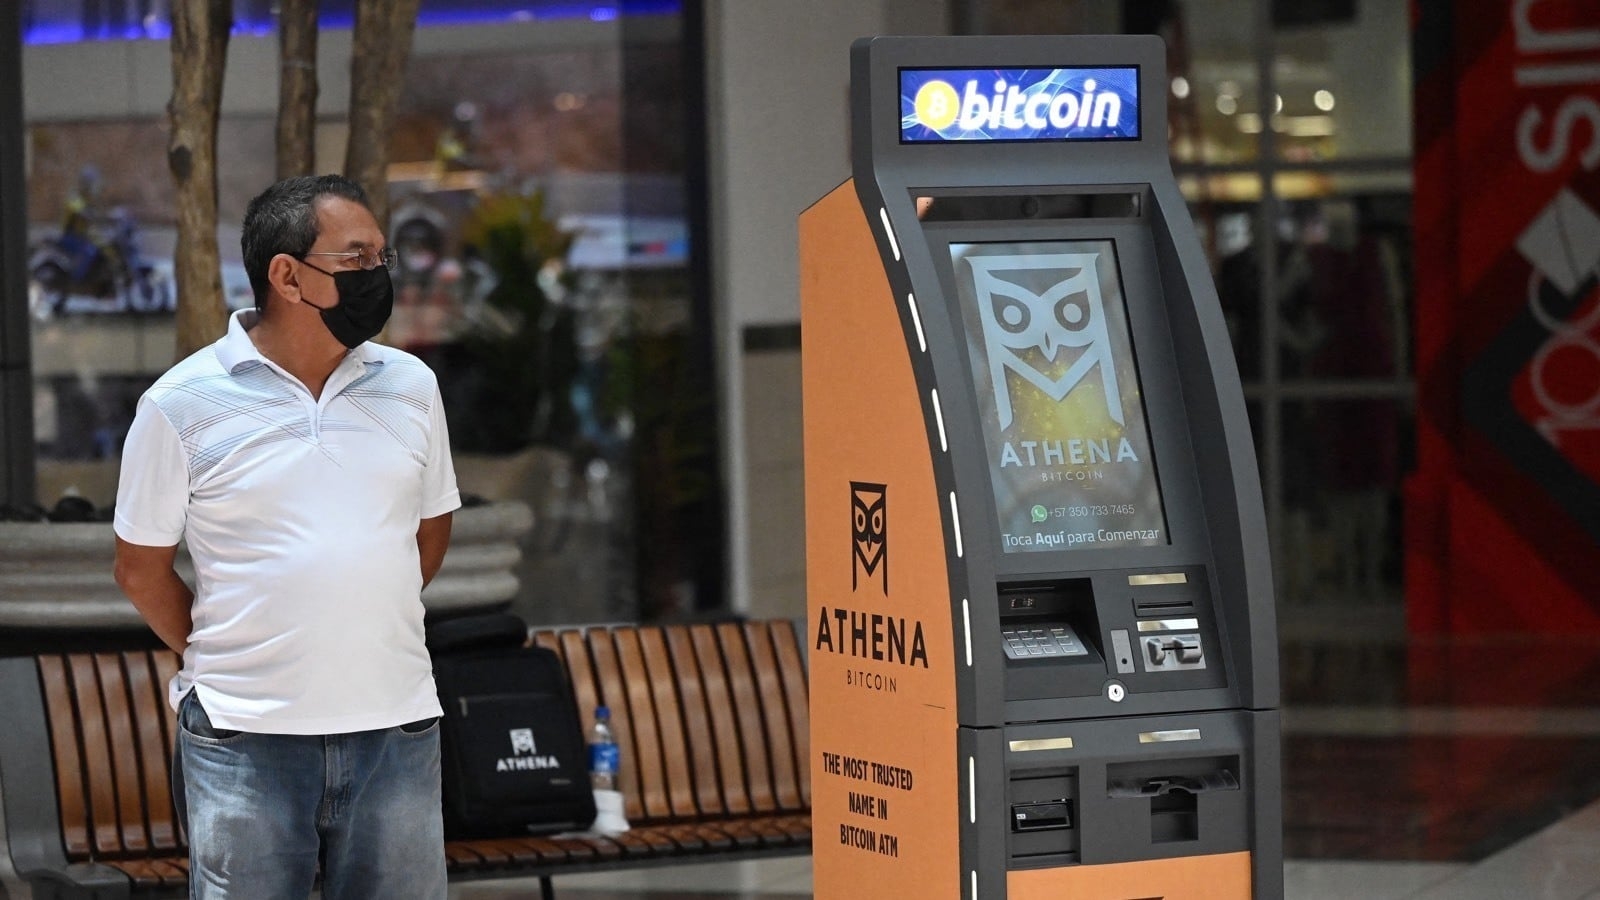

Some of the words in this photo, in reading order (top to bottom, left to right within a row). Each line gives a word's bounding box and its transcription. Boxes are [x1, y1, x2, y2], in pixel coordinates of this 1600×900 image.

[959, 78, 1121, 131] bitcoin
[1000, 437, 1138, 467] ATHENA
[1041, 471, 1103, 482] BITCOIN
[1048, 507, 1066, 518] +57
[1069, 506, 1088, 517] 350
[1090, 505, 1108, 516] 733
[1110, 504, 1135, 515] 7465
[1002, 533, 1033, 547] Toca
[1036, 531, 1065, 547] Aquí
[1068, 531, 1095, 546] para
[1097, 529, 1160, 542] Comenzar
[816, 606, 929, 669] ATHENA
[847, 670, 897, 692] BITCOIN
[496, 756, 560, 772] ATHENA
[823, 752, 841, 776] THE
[843, 756, 868, 782] MOST
[871, 762, 913, 791] TRUSTED
[848, 792, 875, 818] NAME
[877, 797, 888, 820] IN
[840, 824, 876, 852] BITCOIN
[878, 833, 898, 858] ATM
